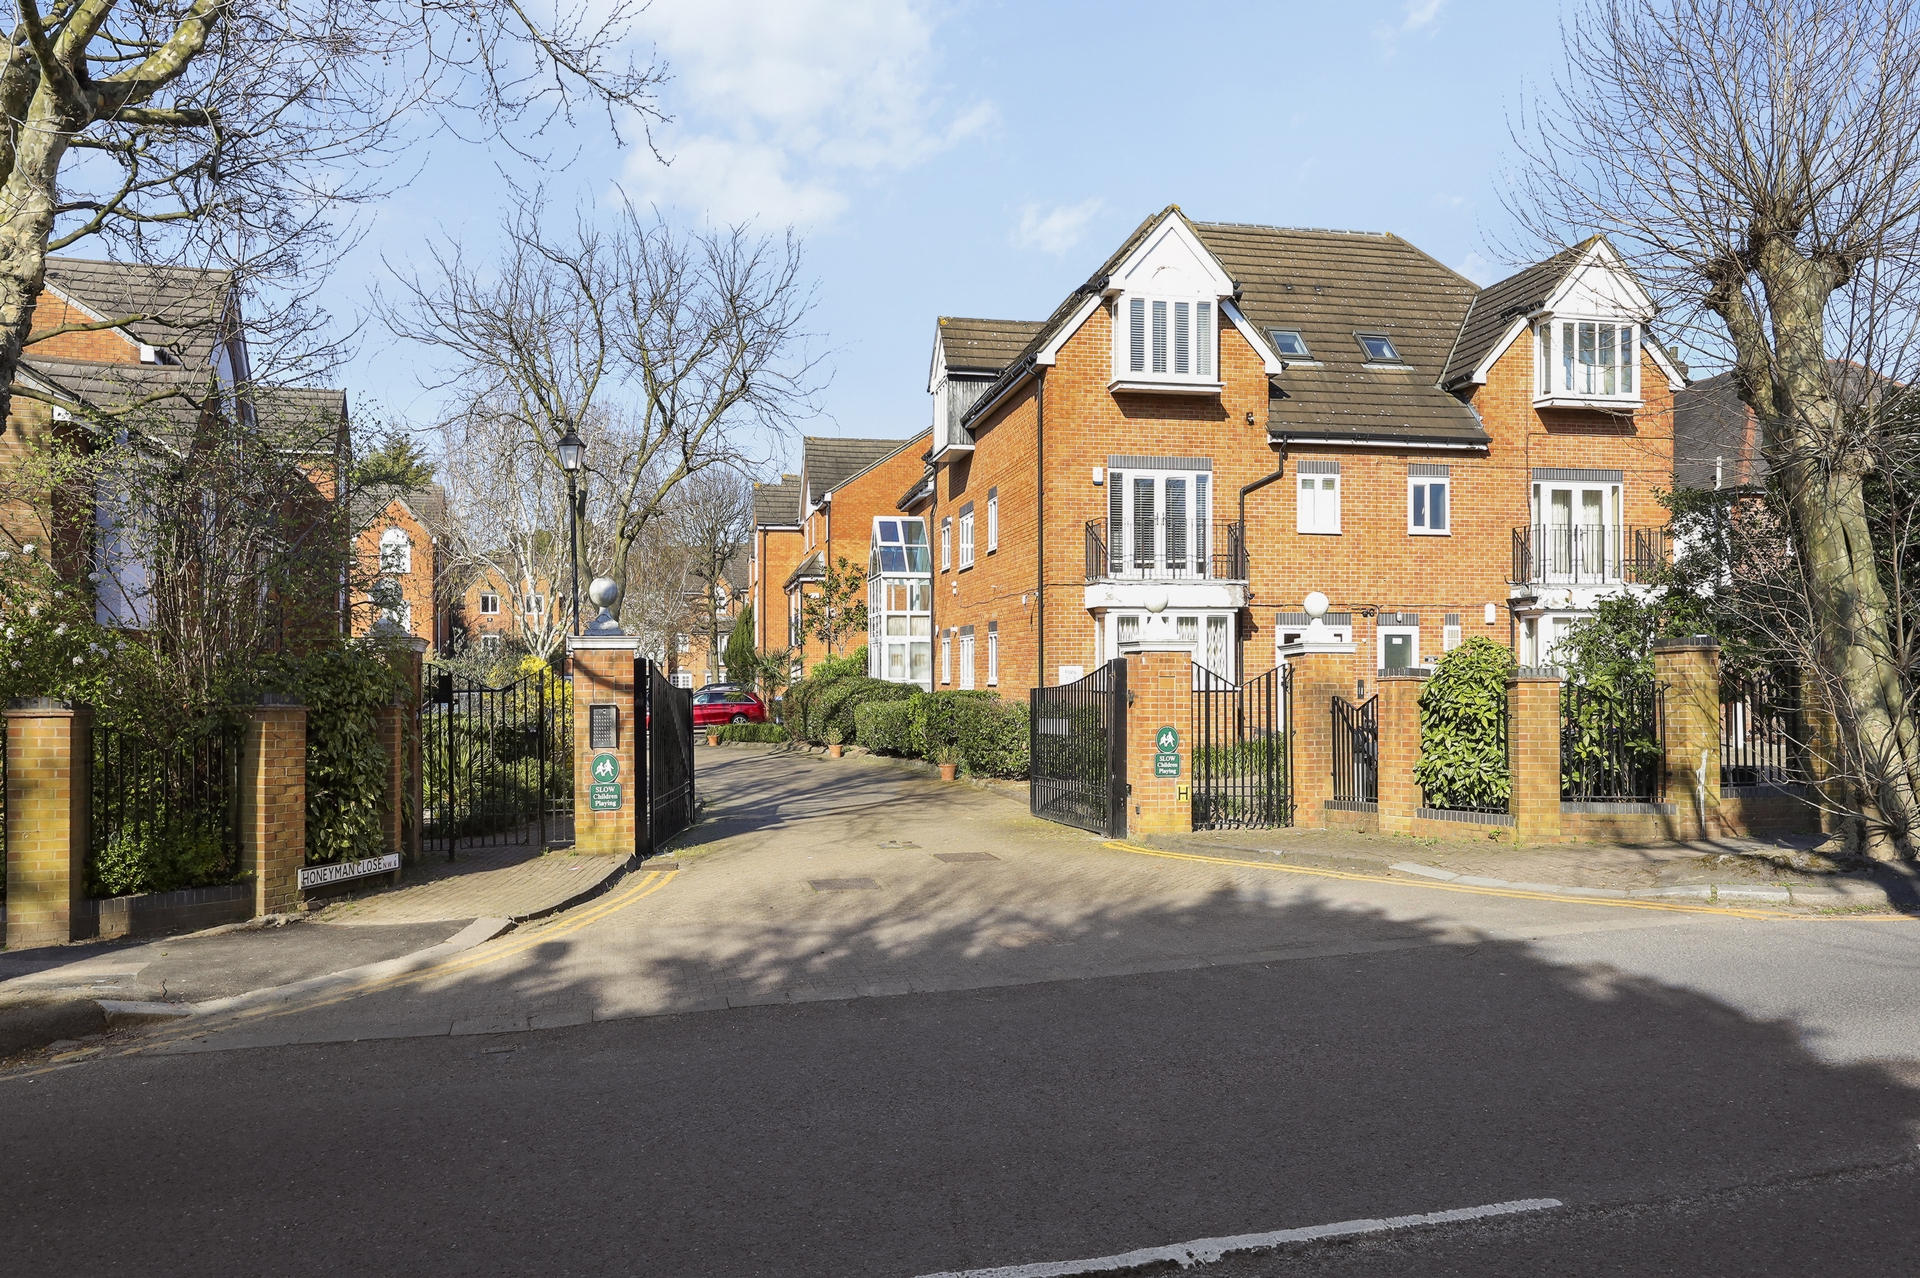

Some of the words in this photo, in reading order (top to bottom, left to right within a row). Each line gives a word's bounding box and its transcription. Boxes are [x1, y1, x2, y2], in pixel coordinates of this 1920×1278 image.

[1178, 786, 1188, 801] H
[302, 865, 355, 886] HONEYMAN
[357, 858, 382, 874] CLOSE
